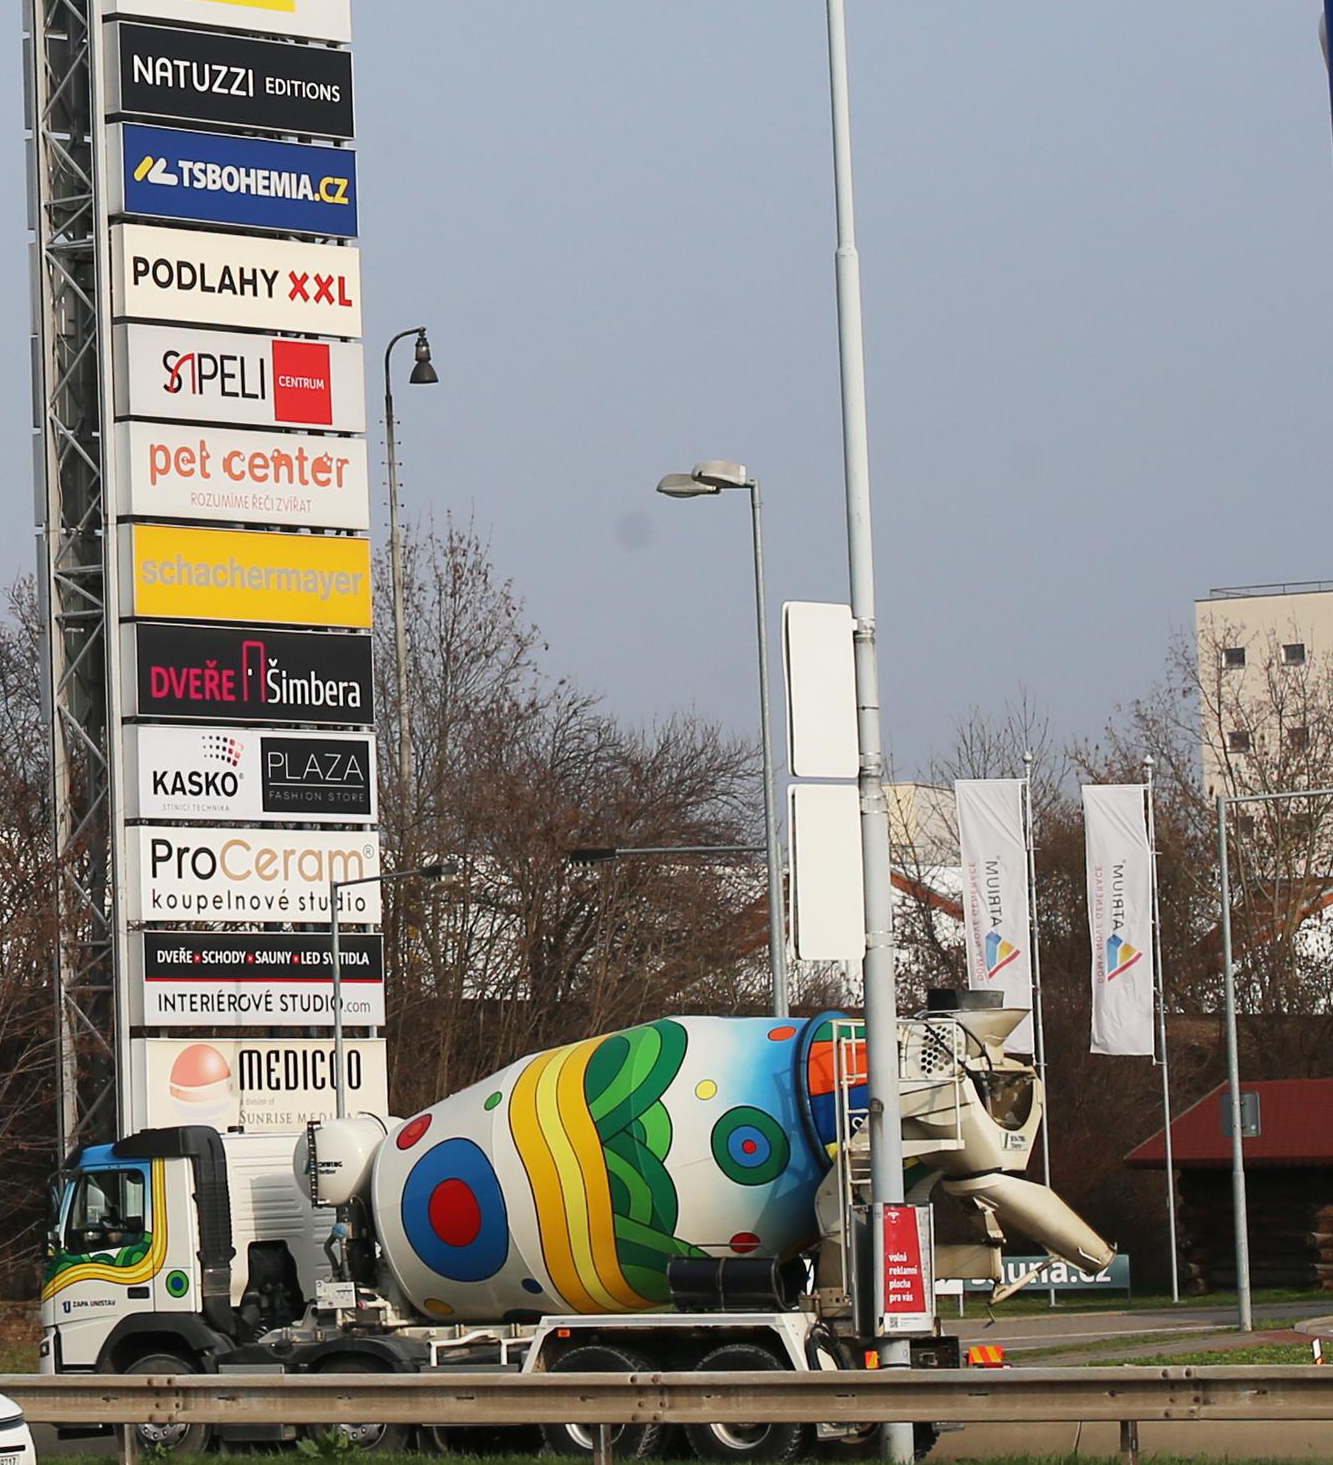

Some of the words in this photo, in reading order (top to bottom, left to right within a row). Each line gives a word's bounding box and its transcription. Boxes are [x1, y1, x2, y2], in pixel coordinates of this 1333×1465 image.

[132, 54, 255, 98] NATUZZI
[265, 76, 341, 103] EDITIONS
[177, 159, 350, 205] TSBOHEMIA.CZ
[132, 255, 279, 298] PODLAHY
[287, 270, 353, 307] XXL
[162, 349, 266, 401] SAPELI
[278, 375, 325, 391] CENTRUM
[149, 439, 211, 486] pet
[222, 446, 350, 488] center
[141, 554, 363, 600] schachermayer
[150, 660, 236, 702] DVEŘE
[265, 657, 361, 708] Šimbera
[152, 770, 239, 797] KASKO
[267, 751, 364, 782] PLAZA
[268, 789, 323, 803] FASHION
[328, 790, 365, 803] STORE
[150, 838, 365, 882] ProCeram
[152, 888, 290, 915] koupelnové
[157, 947, 193, 965] DVEŘE
[202, 950, 247, 965] SCHODY
[254, 951, 293, 965] SAUNY
[301, 951, 321, 965] LED
[322, 951, 370, 965] SVTIDLA
[157, 990, 273, 1013] INTERIÉROVÉ
[889, 1293, 902, 1304] pro
